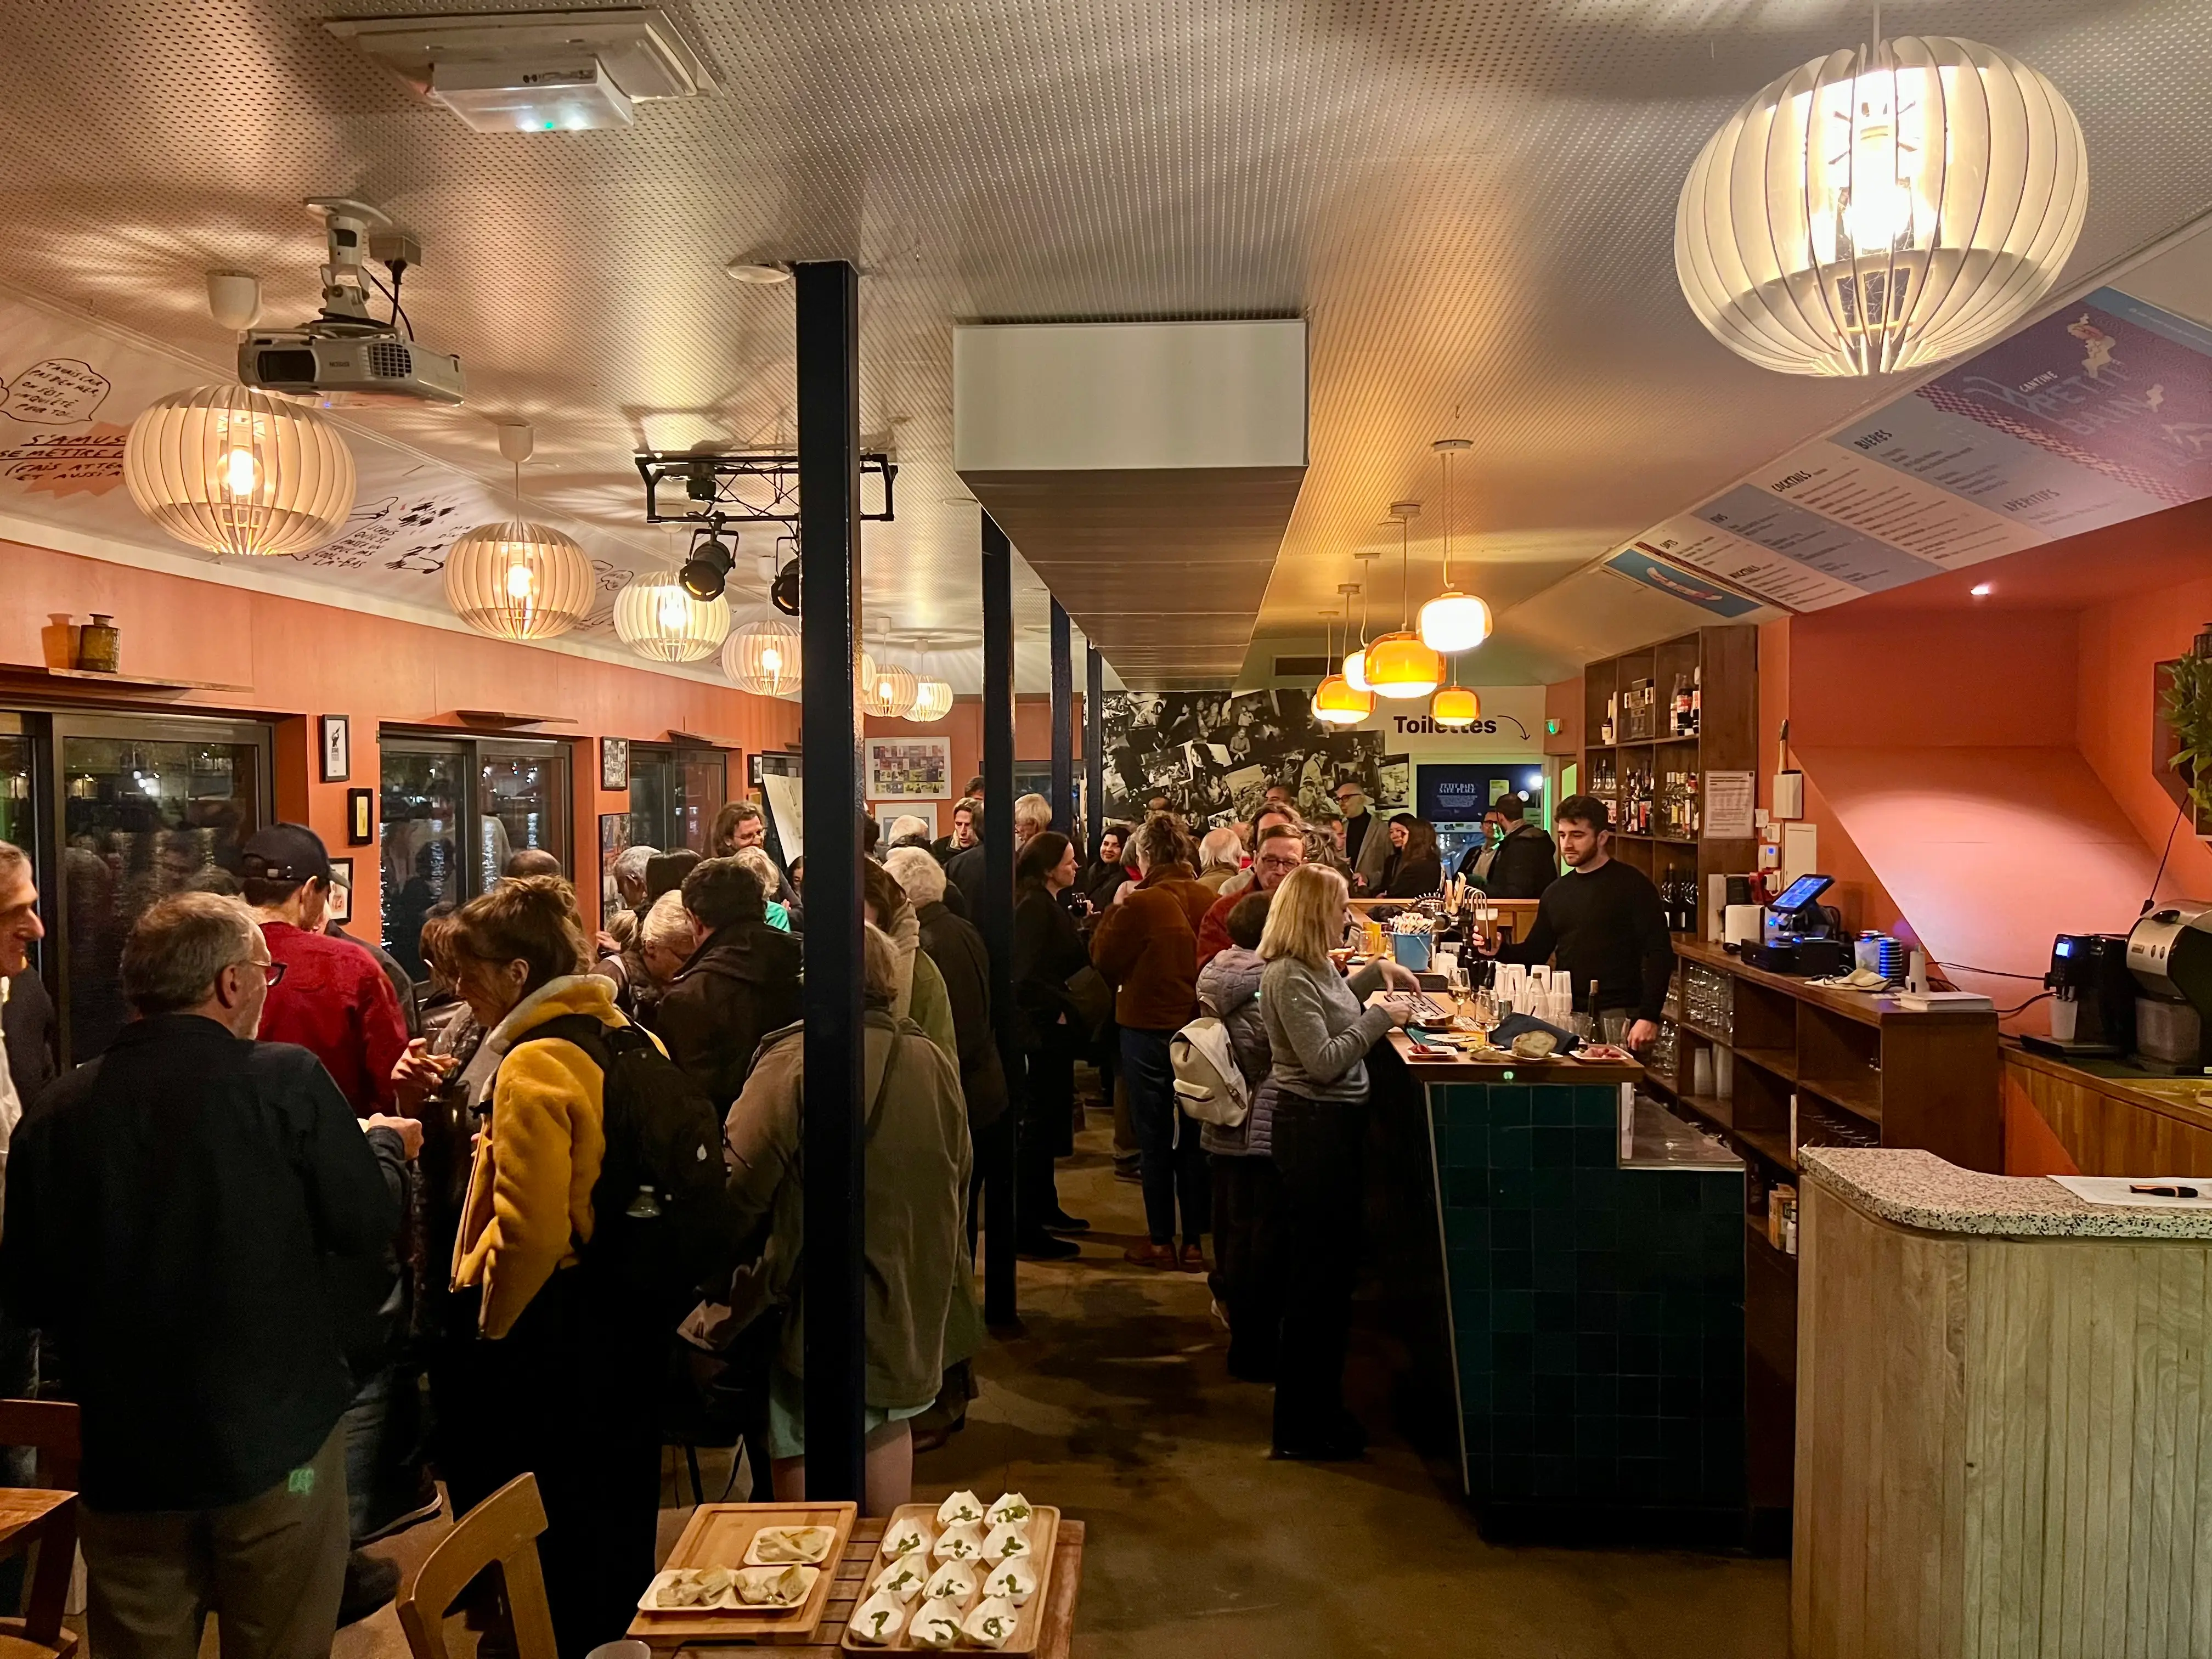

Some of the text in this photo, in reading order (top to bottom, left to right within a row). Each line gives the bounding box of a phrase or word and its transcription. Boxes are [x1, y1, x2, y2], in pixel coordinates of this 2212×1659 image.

[2019, 370, 2058, 392] CANTINE
[1854, 430, 1892, 449] BIÈRES
[26, 448, 109, 458] METTRE
[1771, 470, 1812, 492] COCKTAILS
[2002, 488, 2061, 512] APÉRITIFS
